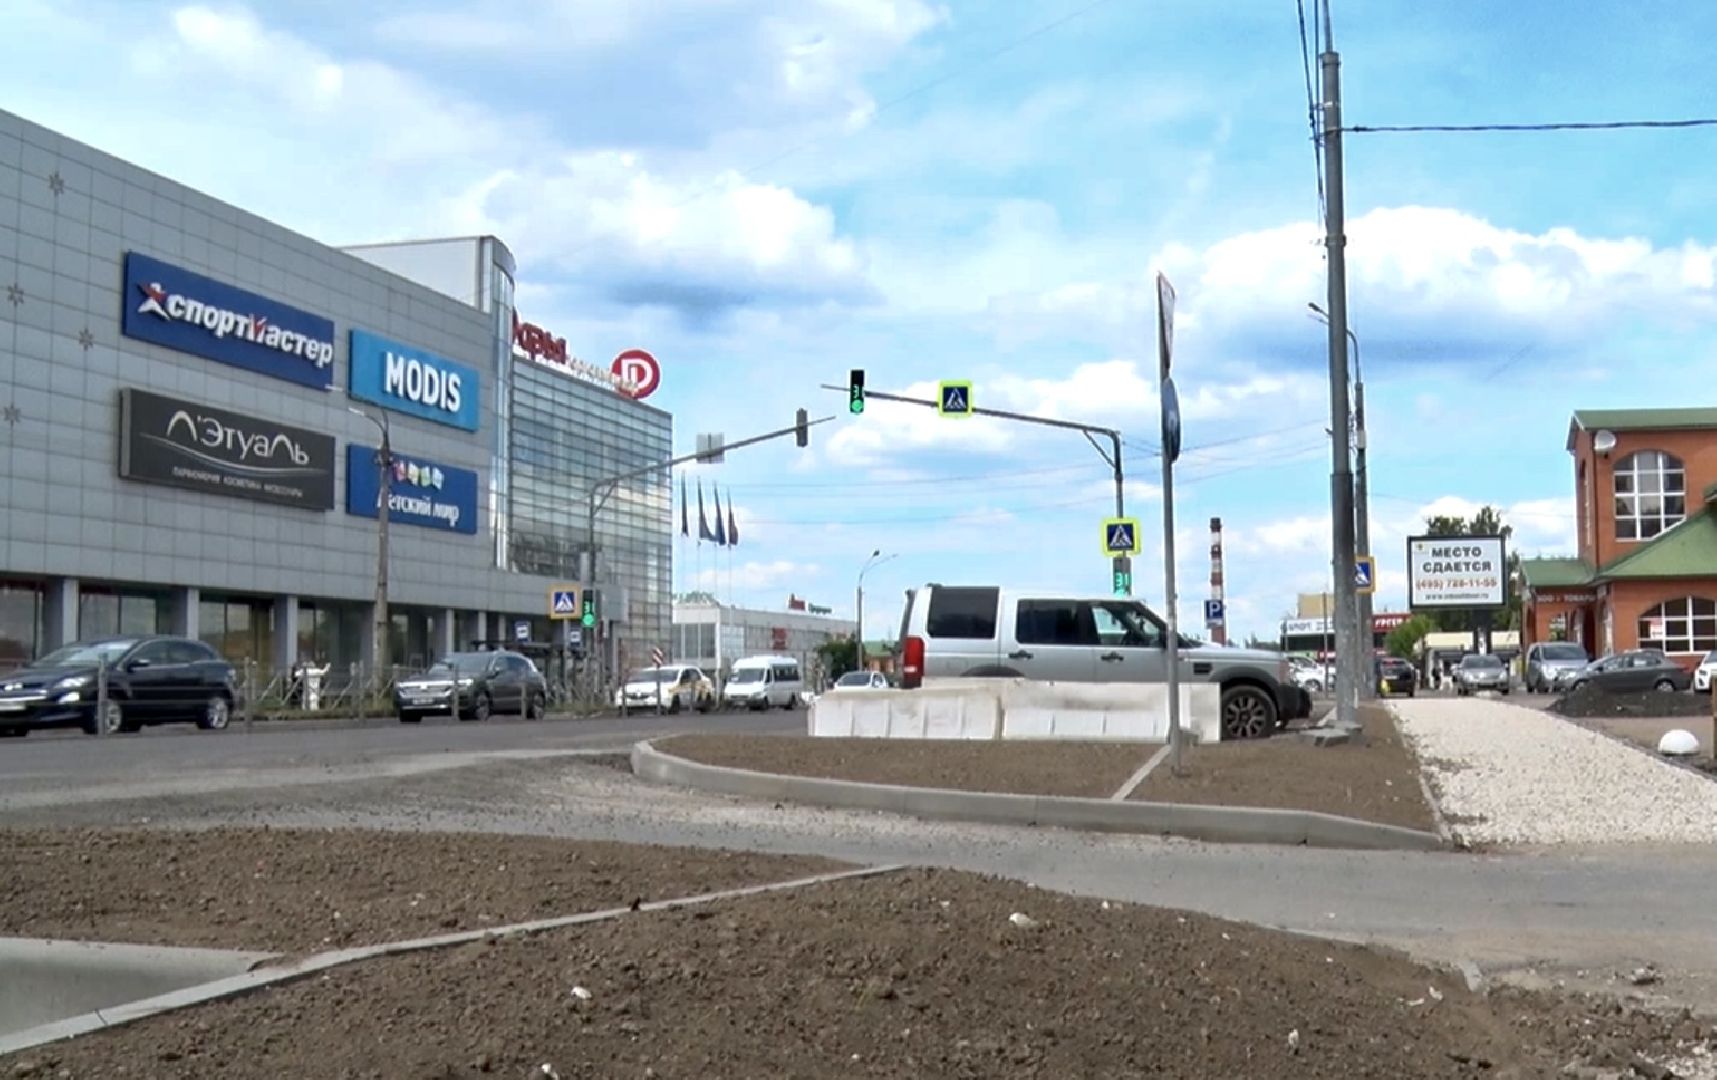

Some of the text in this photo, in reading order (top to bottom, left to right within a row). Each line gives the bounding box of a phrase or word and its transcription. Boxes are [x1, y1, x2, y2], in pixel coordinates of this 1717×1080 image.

[386, 351, 461, 412] MODIS
[1432, 546, 1482, 558] МЕСТО
[1423, 561, 1492, 573] СДАЕТСЯ
[1115, 572, 1129, 588] 31
